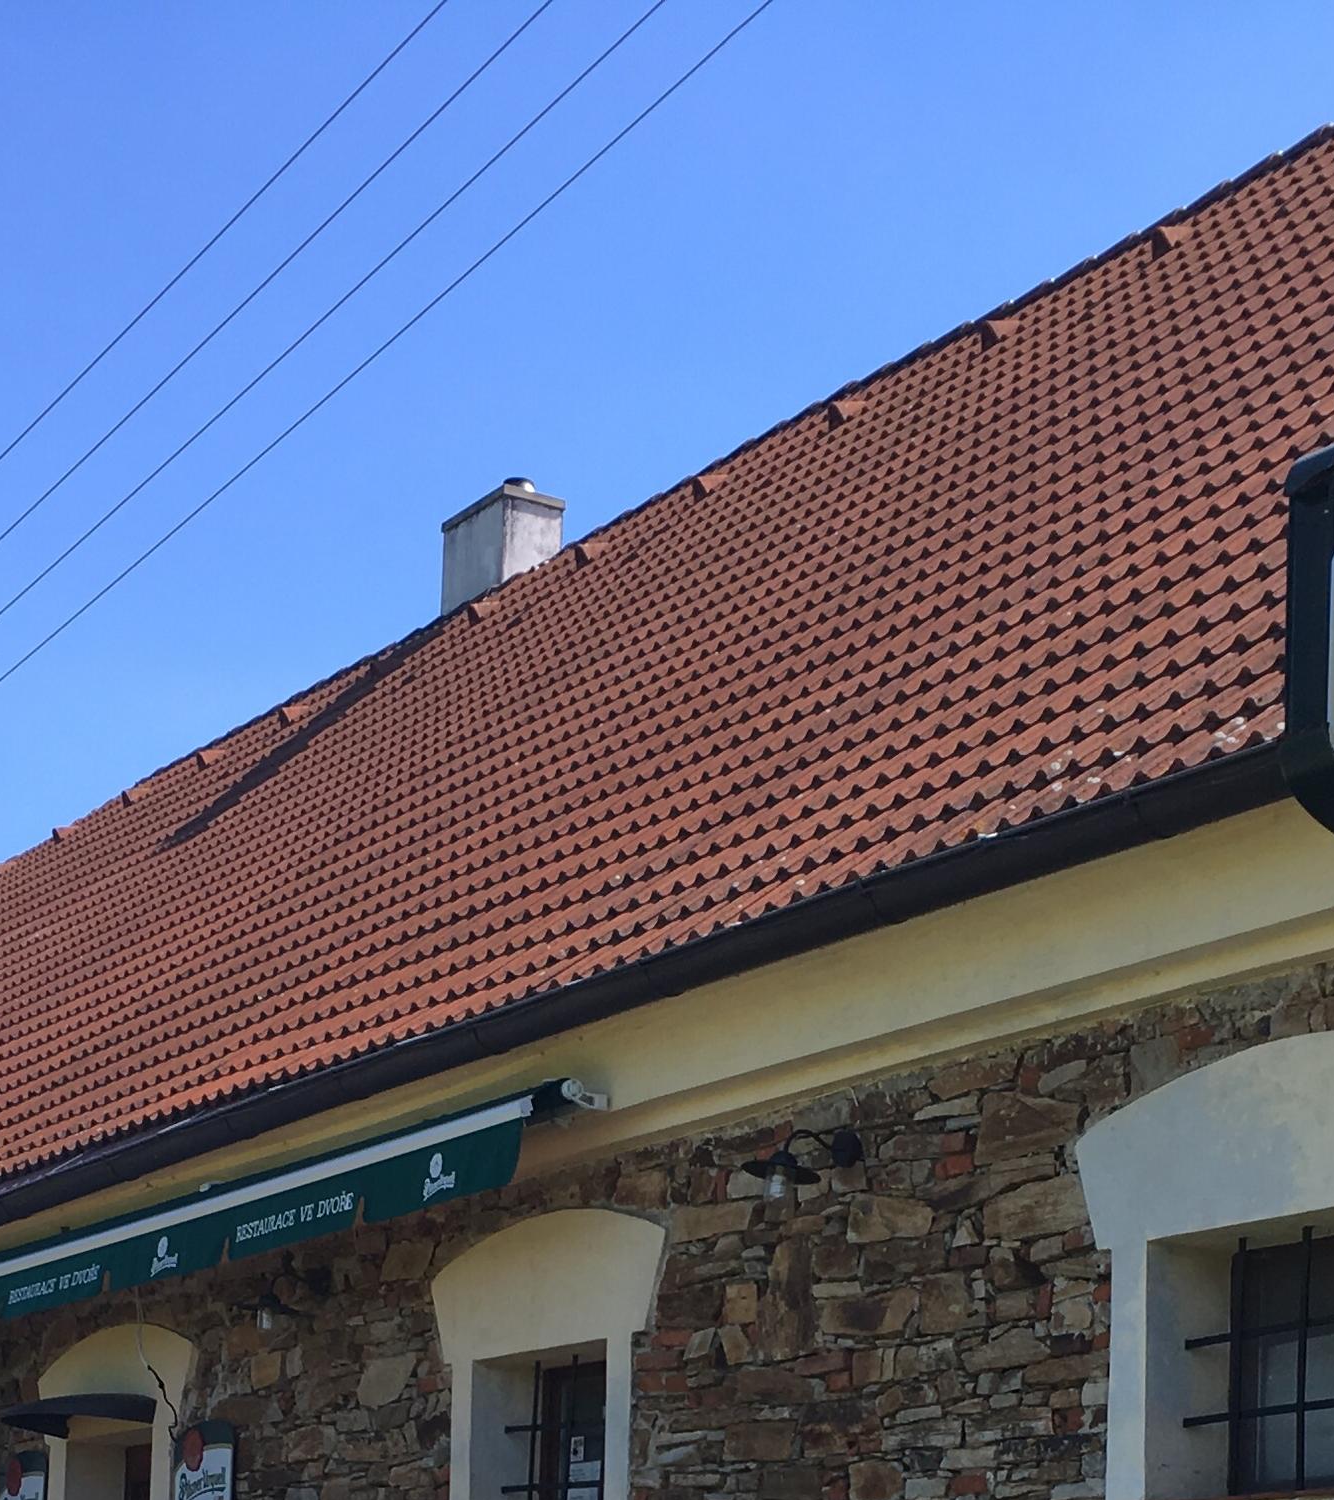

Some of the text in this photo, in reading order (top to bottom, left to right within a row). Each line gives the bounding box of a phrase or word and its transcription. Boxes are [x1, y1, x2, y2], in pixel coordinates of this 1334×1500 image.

[235, 1191, 354, 1243] RESTAURACE VE DVOŘE
